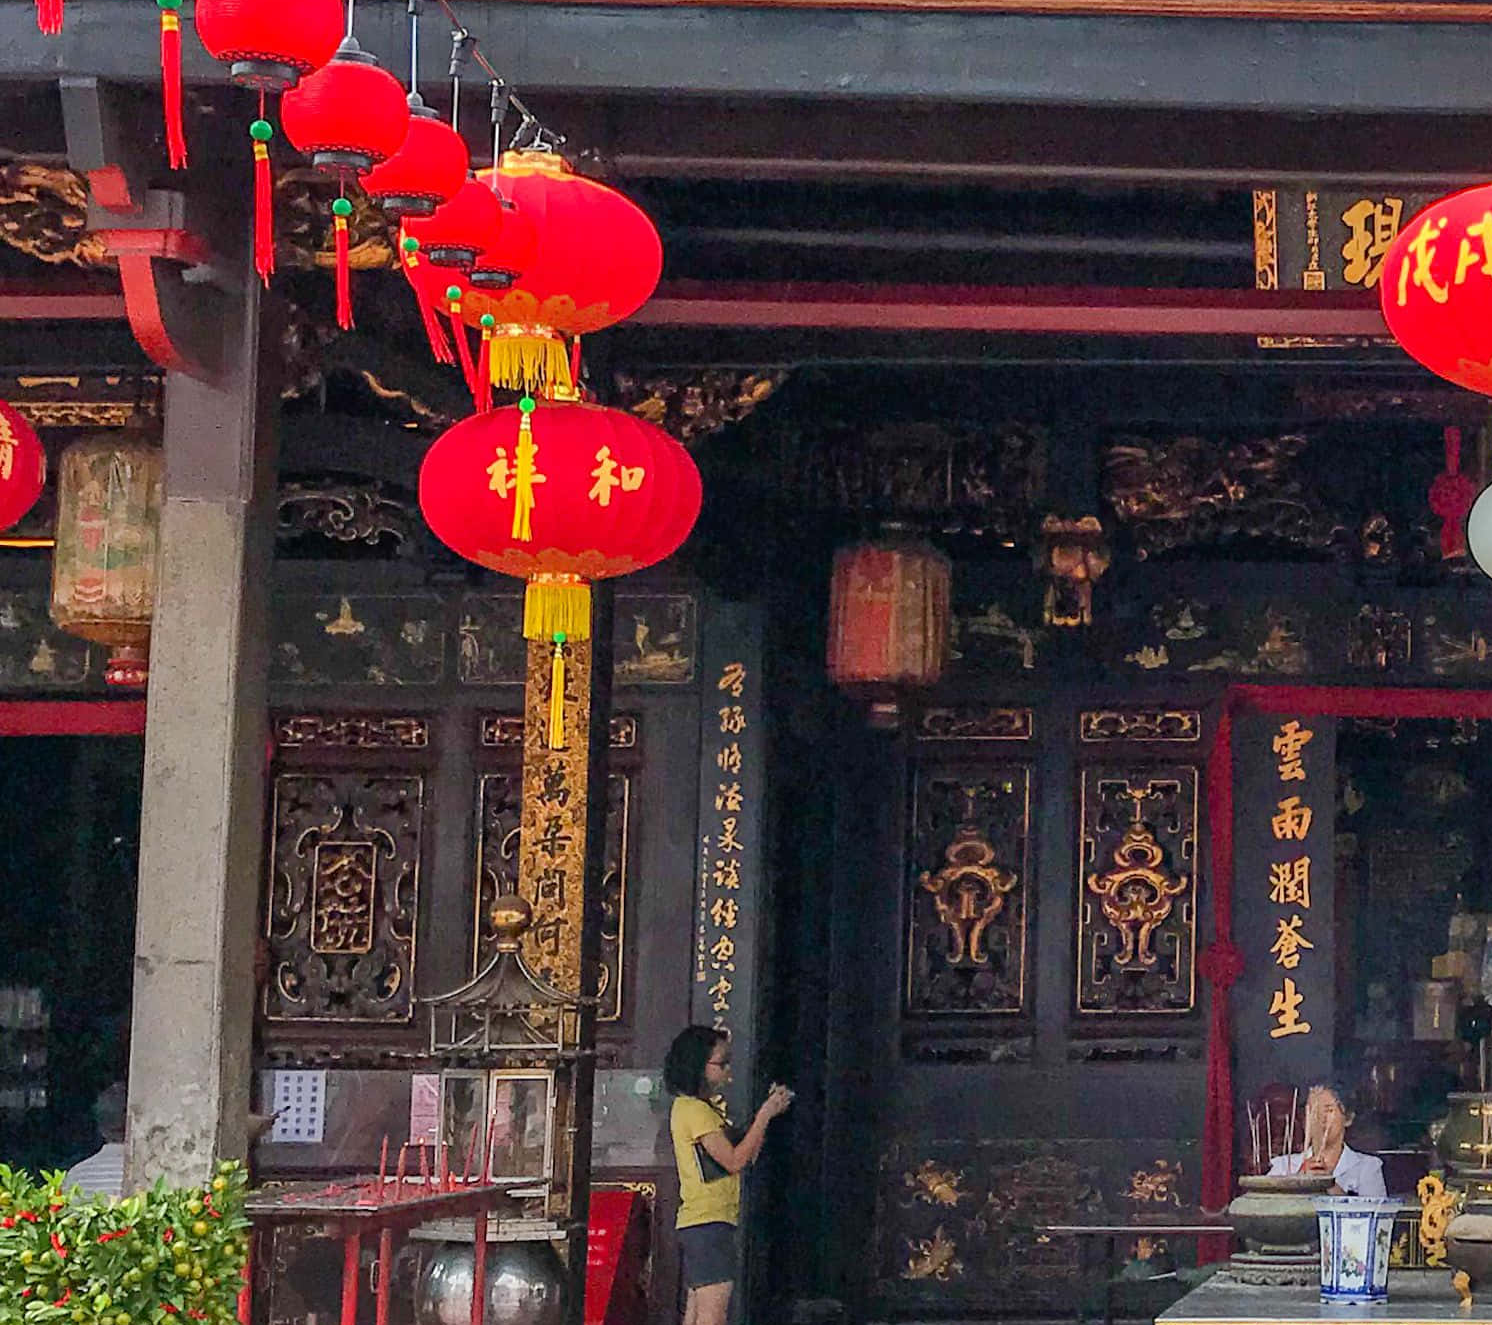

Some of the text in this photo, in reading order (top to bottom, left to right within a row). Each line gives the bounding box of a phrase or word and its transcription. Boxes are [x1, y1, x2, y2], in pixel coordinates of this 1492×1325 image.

[486, 445, 646, 509] 祥和
[1268, 720, 1314, 1039] 雲雨潤蒼生
